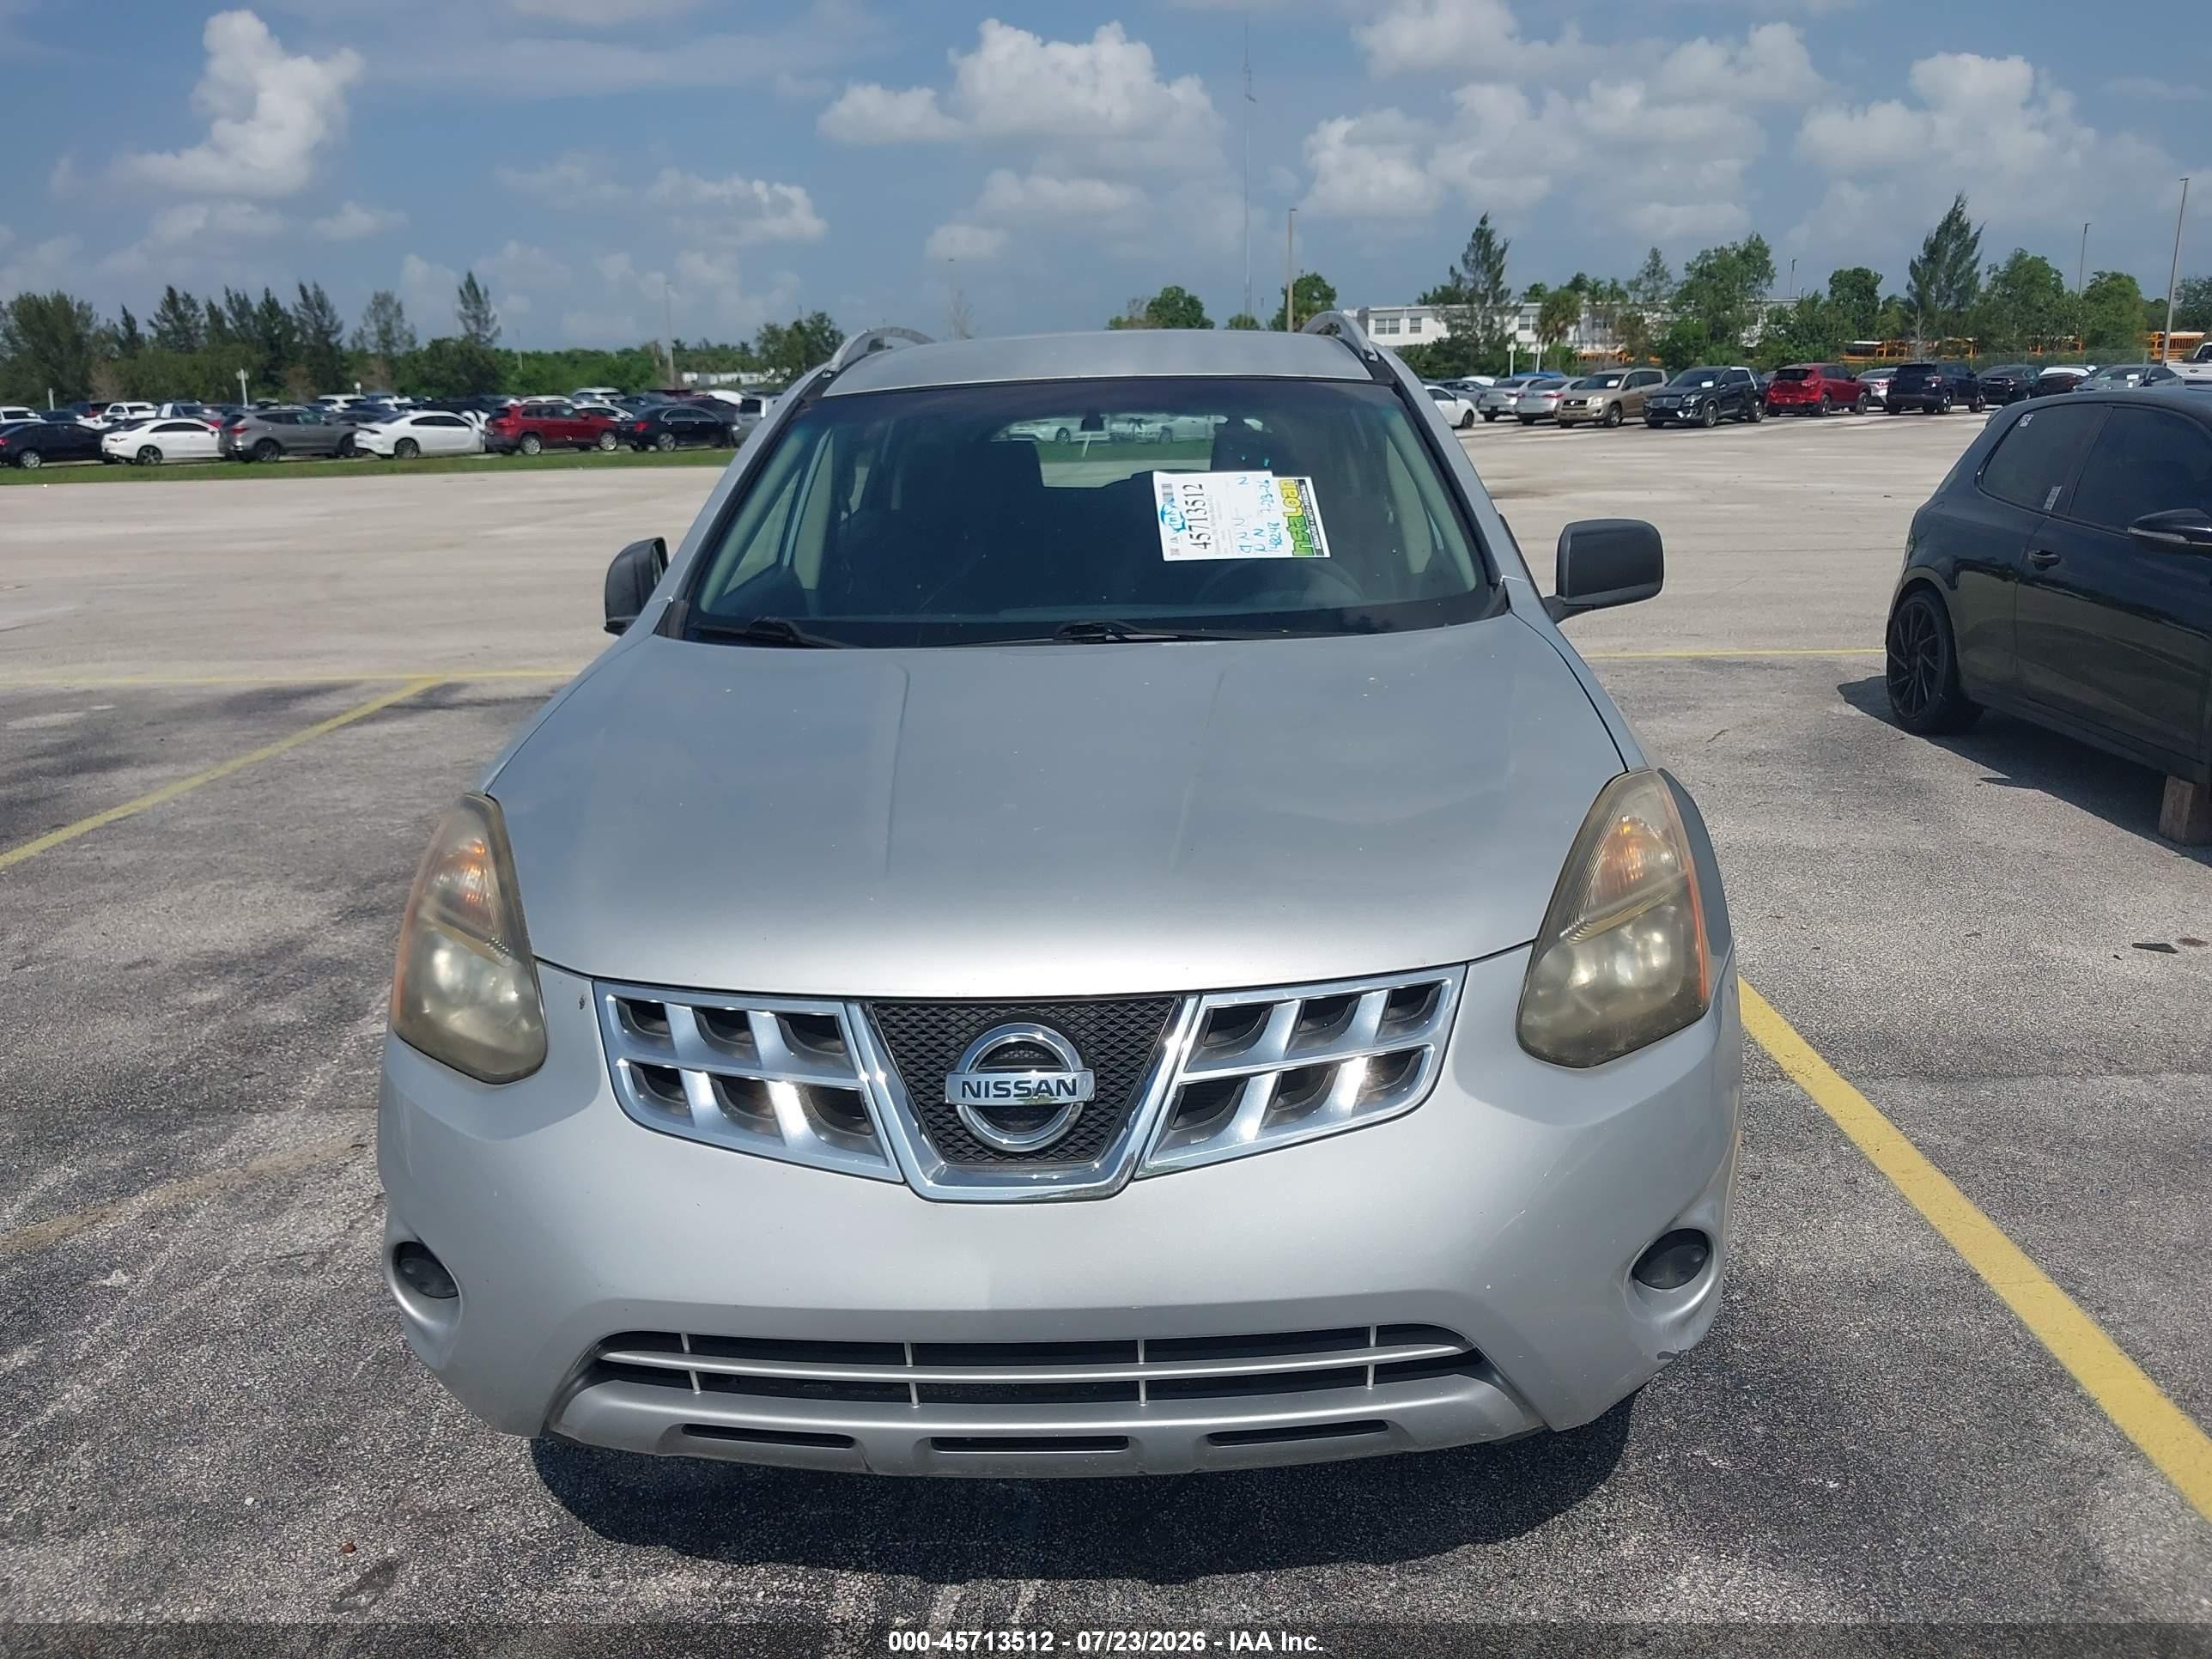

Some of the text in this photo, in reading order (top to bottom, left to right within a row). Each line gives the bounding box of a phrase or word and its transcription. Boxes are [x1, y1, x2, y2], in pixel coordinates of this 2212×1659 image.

[1182, 483, 1211, 550] 45713512
[1278, 478, 1316, 556] InstaLoan
[1305, 509, 1316, 522] AUTO
[961, 1078, 1078, 1099] NISSAN
